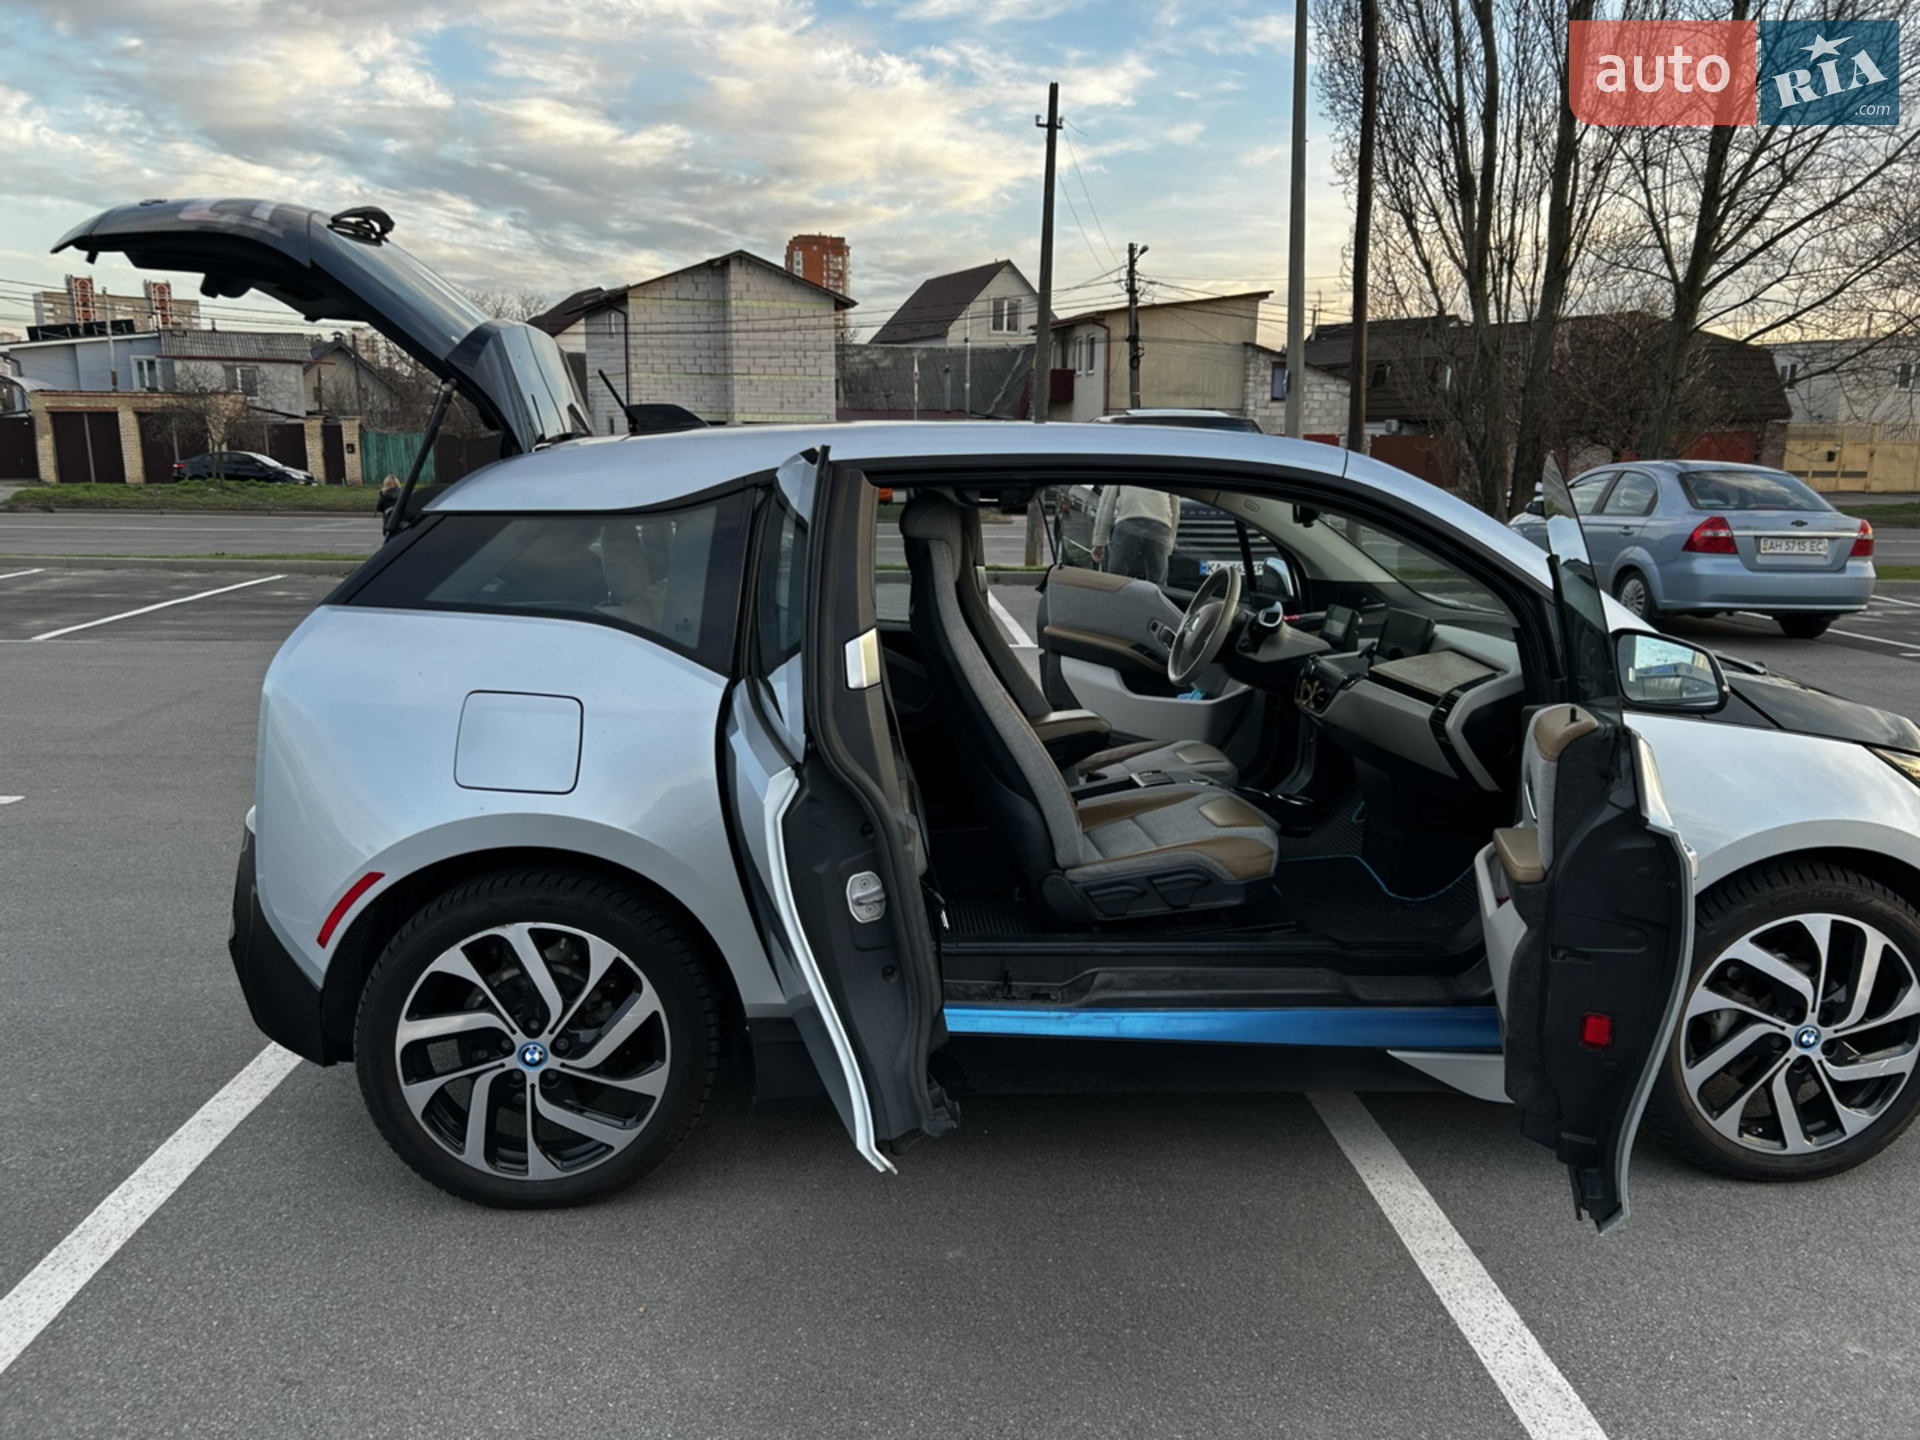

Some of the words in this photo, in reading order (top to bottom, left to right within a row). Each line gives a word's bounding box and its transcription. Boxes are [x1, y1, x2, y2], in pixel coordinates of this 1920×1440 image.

[1769, 540, 1782, 551] AH
[1785, 540, 1807, 551] 5715
[1810, 541, 1823, 552] EC
